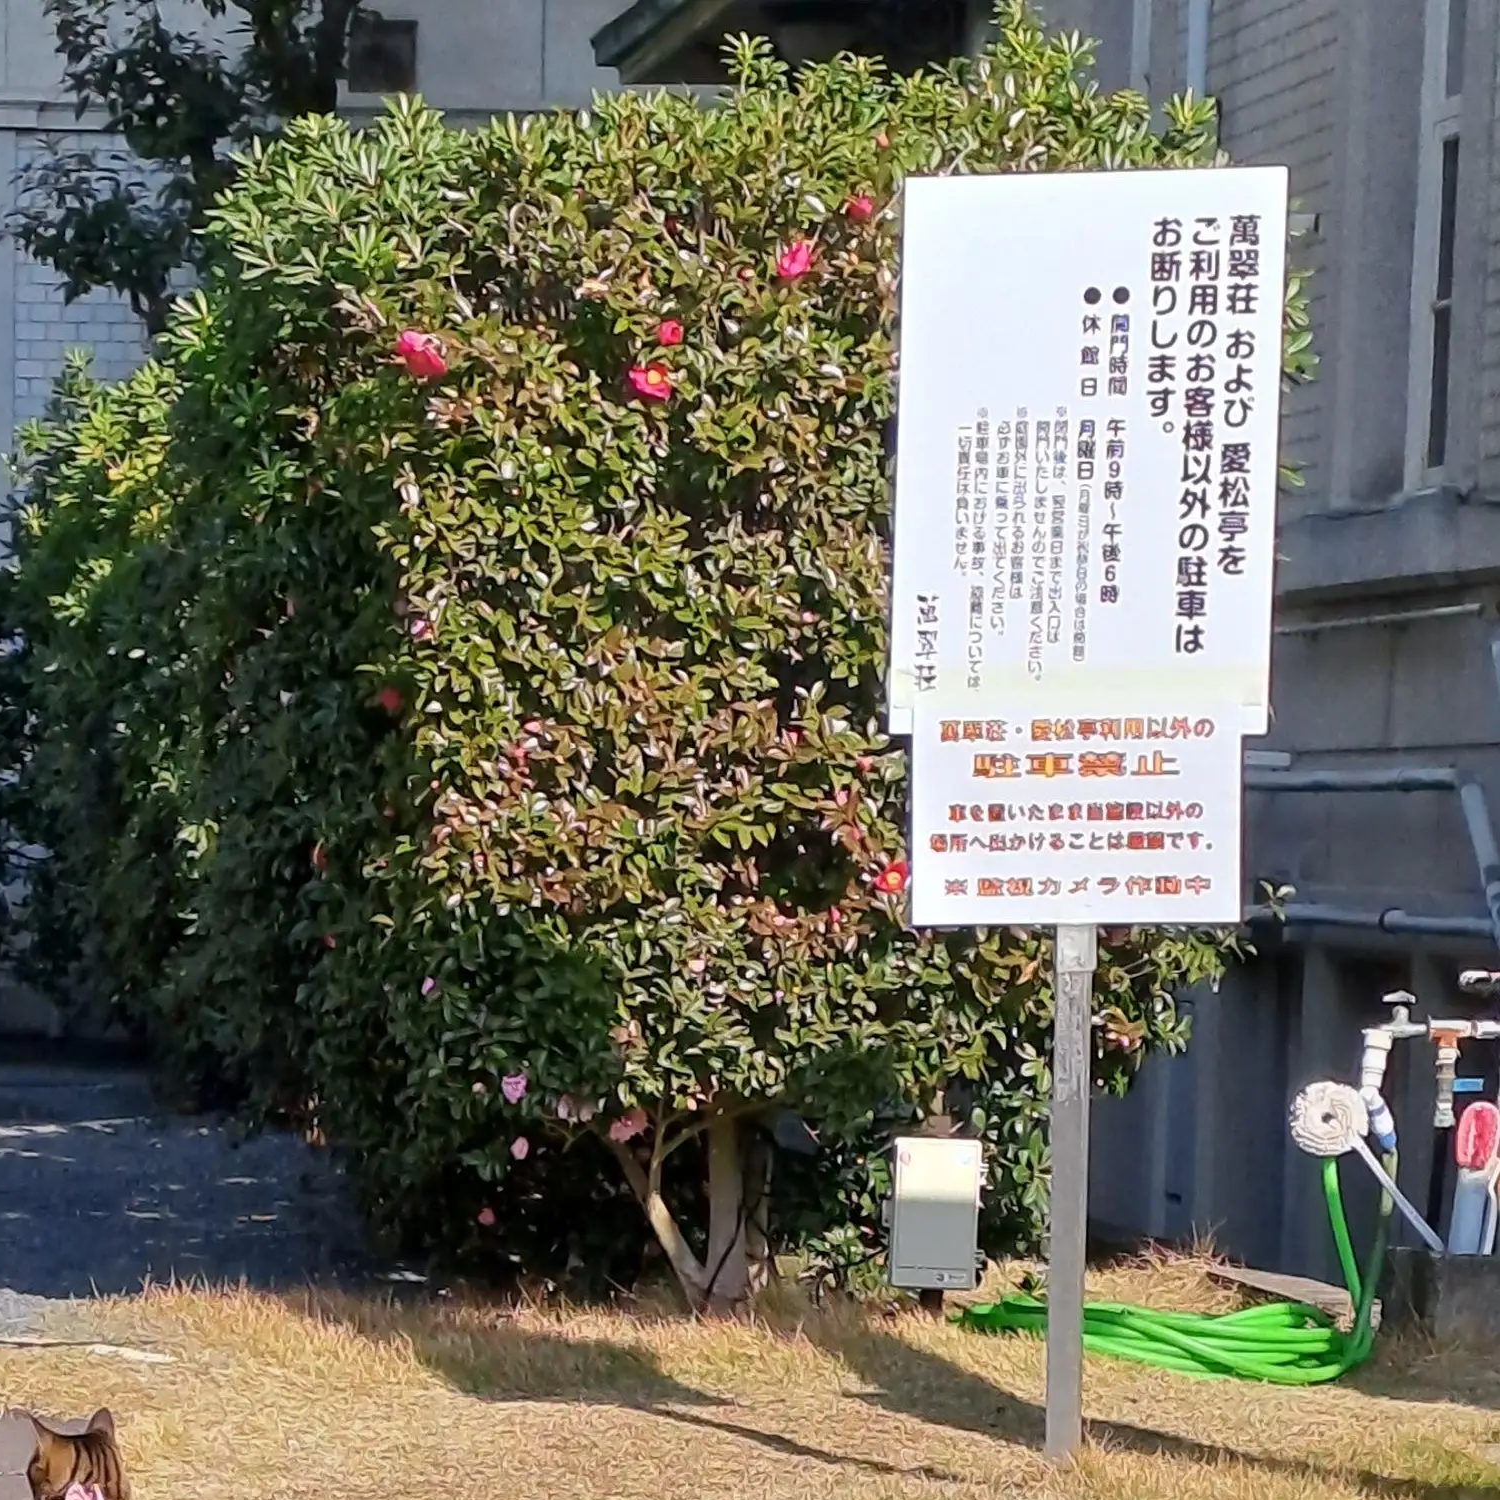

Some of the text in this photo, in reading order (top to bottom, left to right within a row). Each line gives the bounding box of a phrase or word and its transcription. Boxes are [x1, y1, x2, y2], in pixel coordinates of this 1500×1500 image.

[1146, 216, 1183, 434] お断りします。
[1174, 217, 1221, 654] ご利用のお客様以外の駐車は
[1217, 214, 1262, 576] 萬翠荘 および 愛松亭を
[971, 749, 1181, 779] 駐車禁止
